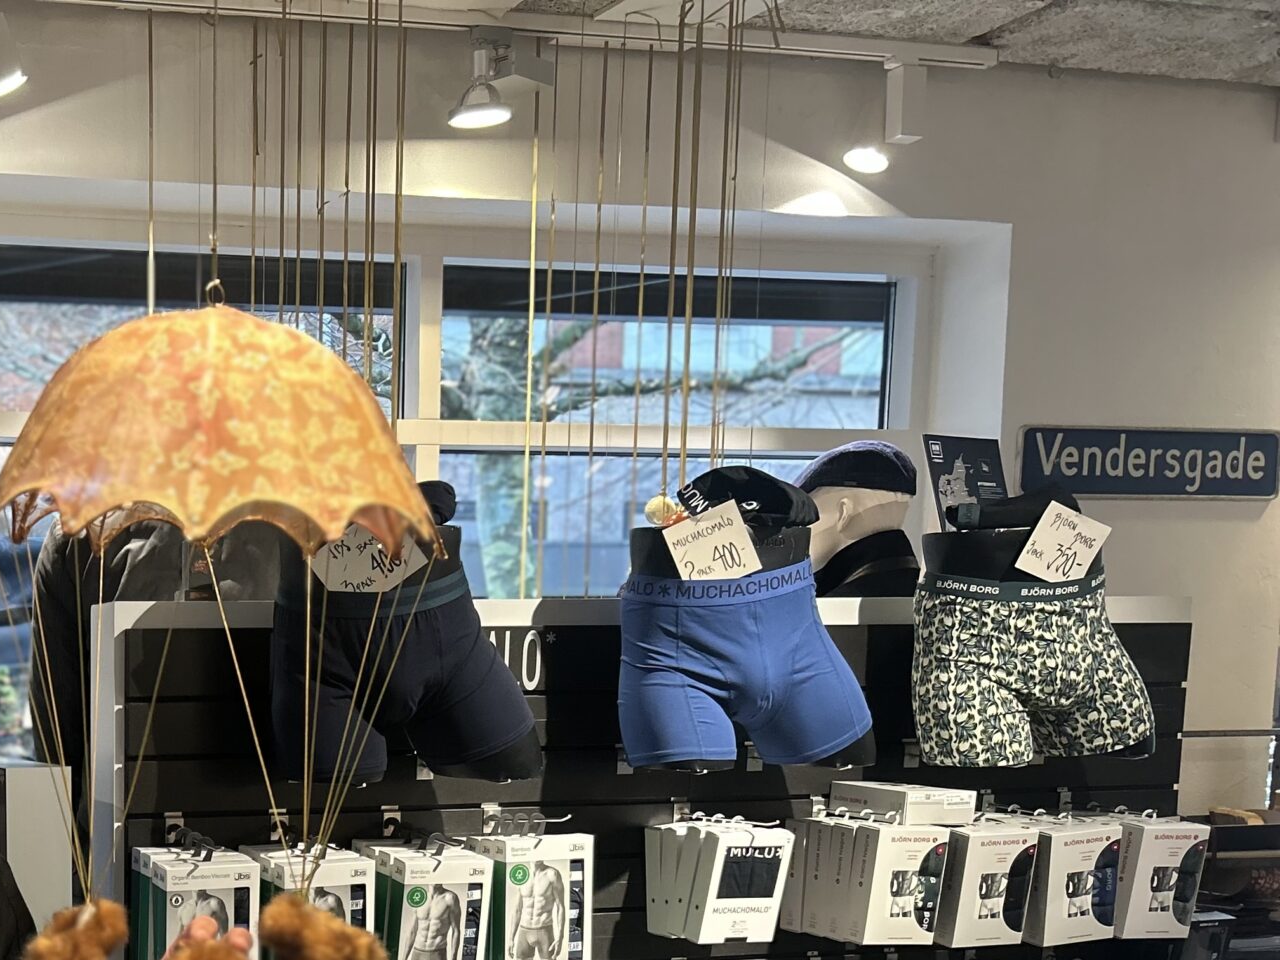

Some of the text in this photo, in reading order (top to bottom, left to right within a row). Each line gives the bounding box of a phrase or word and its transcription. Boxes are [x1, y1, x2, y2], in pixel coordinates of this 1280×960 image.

[1035, 432, 1266, 493] Vendersgade
[936, 578, 1000, 595] BJÖRN BORG
[1020, 585, 1079, 597] BJÖRN BORG
[712, 906, 769, 914] MUCHACHOMALO
